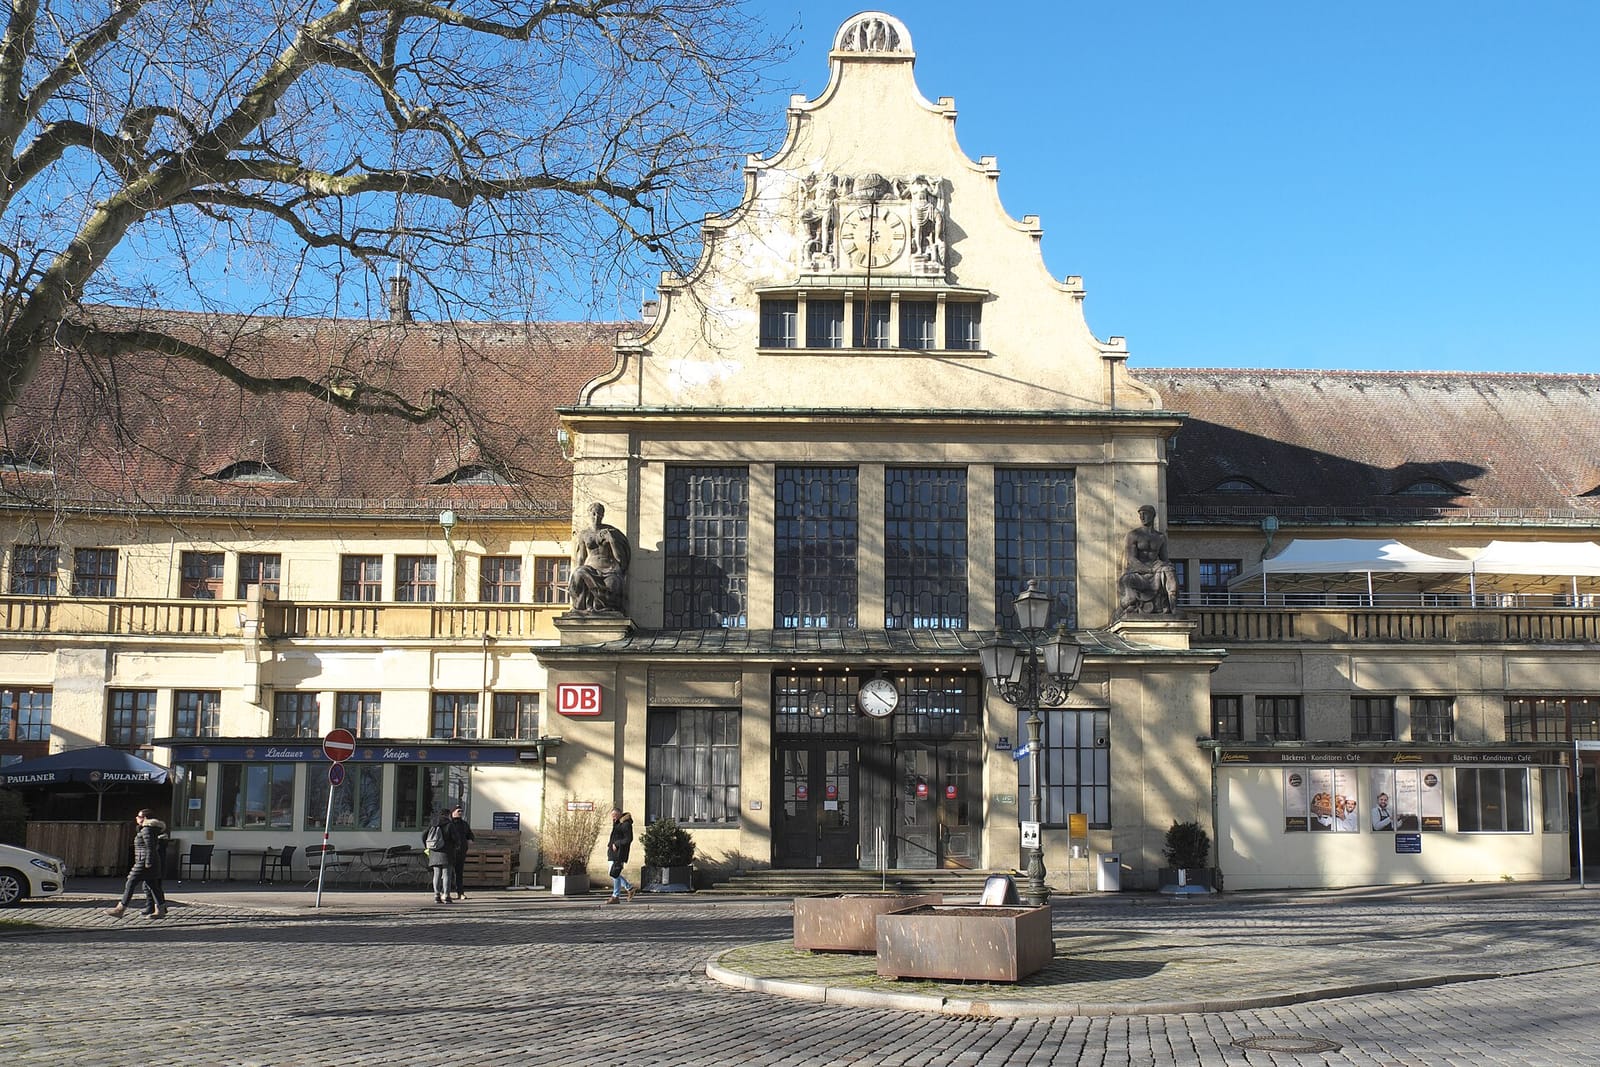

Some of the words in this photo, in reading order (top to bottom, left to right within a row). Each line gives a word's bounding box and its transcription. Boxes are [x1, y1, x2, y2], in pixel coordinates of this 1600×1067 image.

[562, 688, 596, 709] DB
[265, 747, 303, 758] Lindauer
[383, 748, 409, 760] Kneipe
[7, 773, 56, 784] PAULANER
[103, 772, 150, 781] PAULANER
